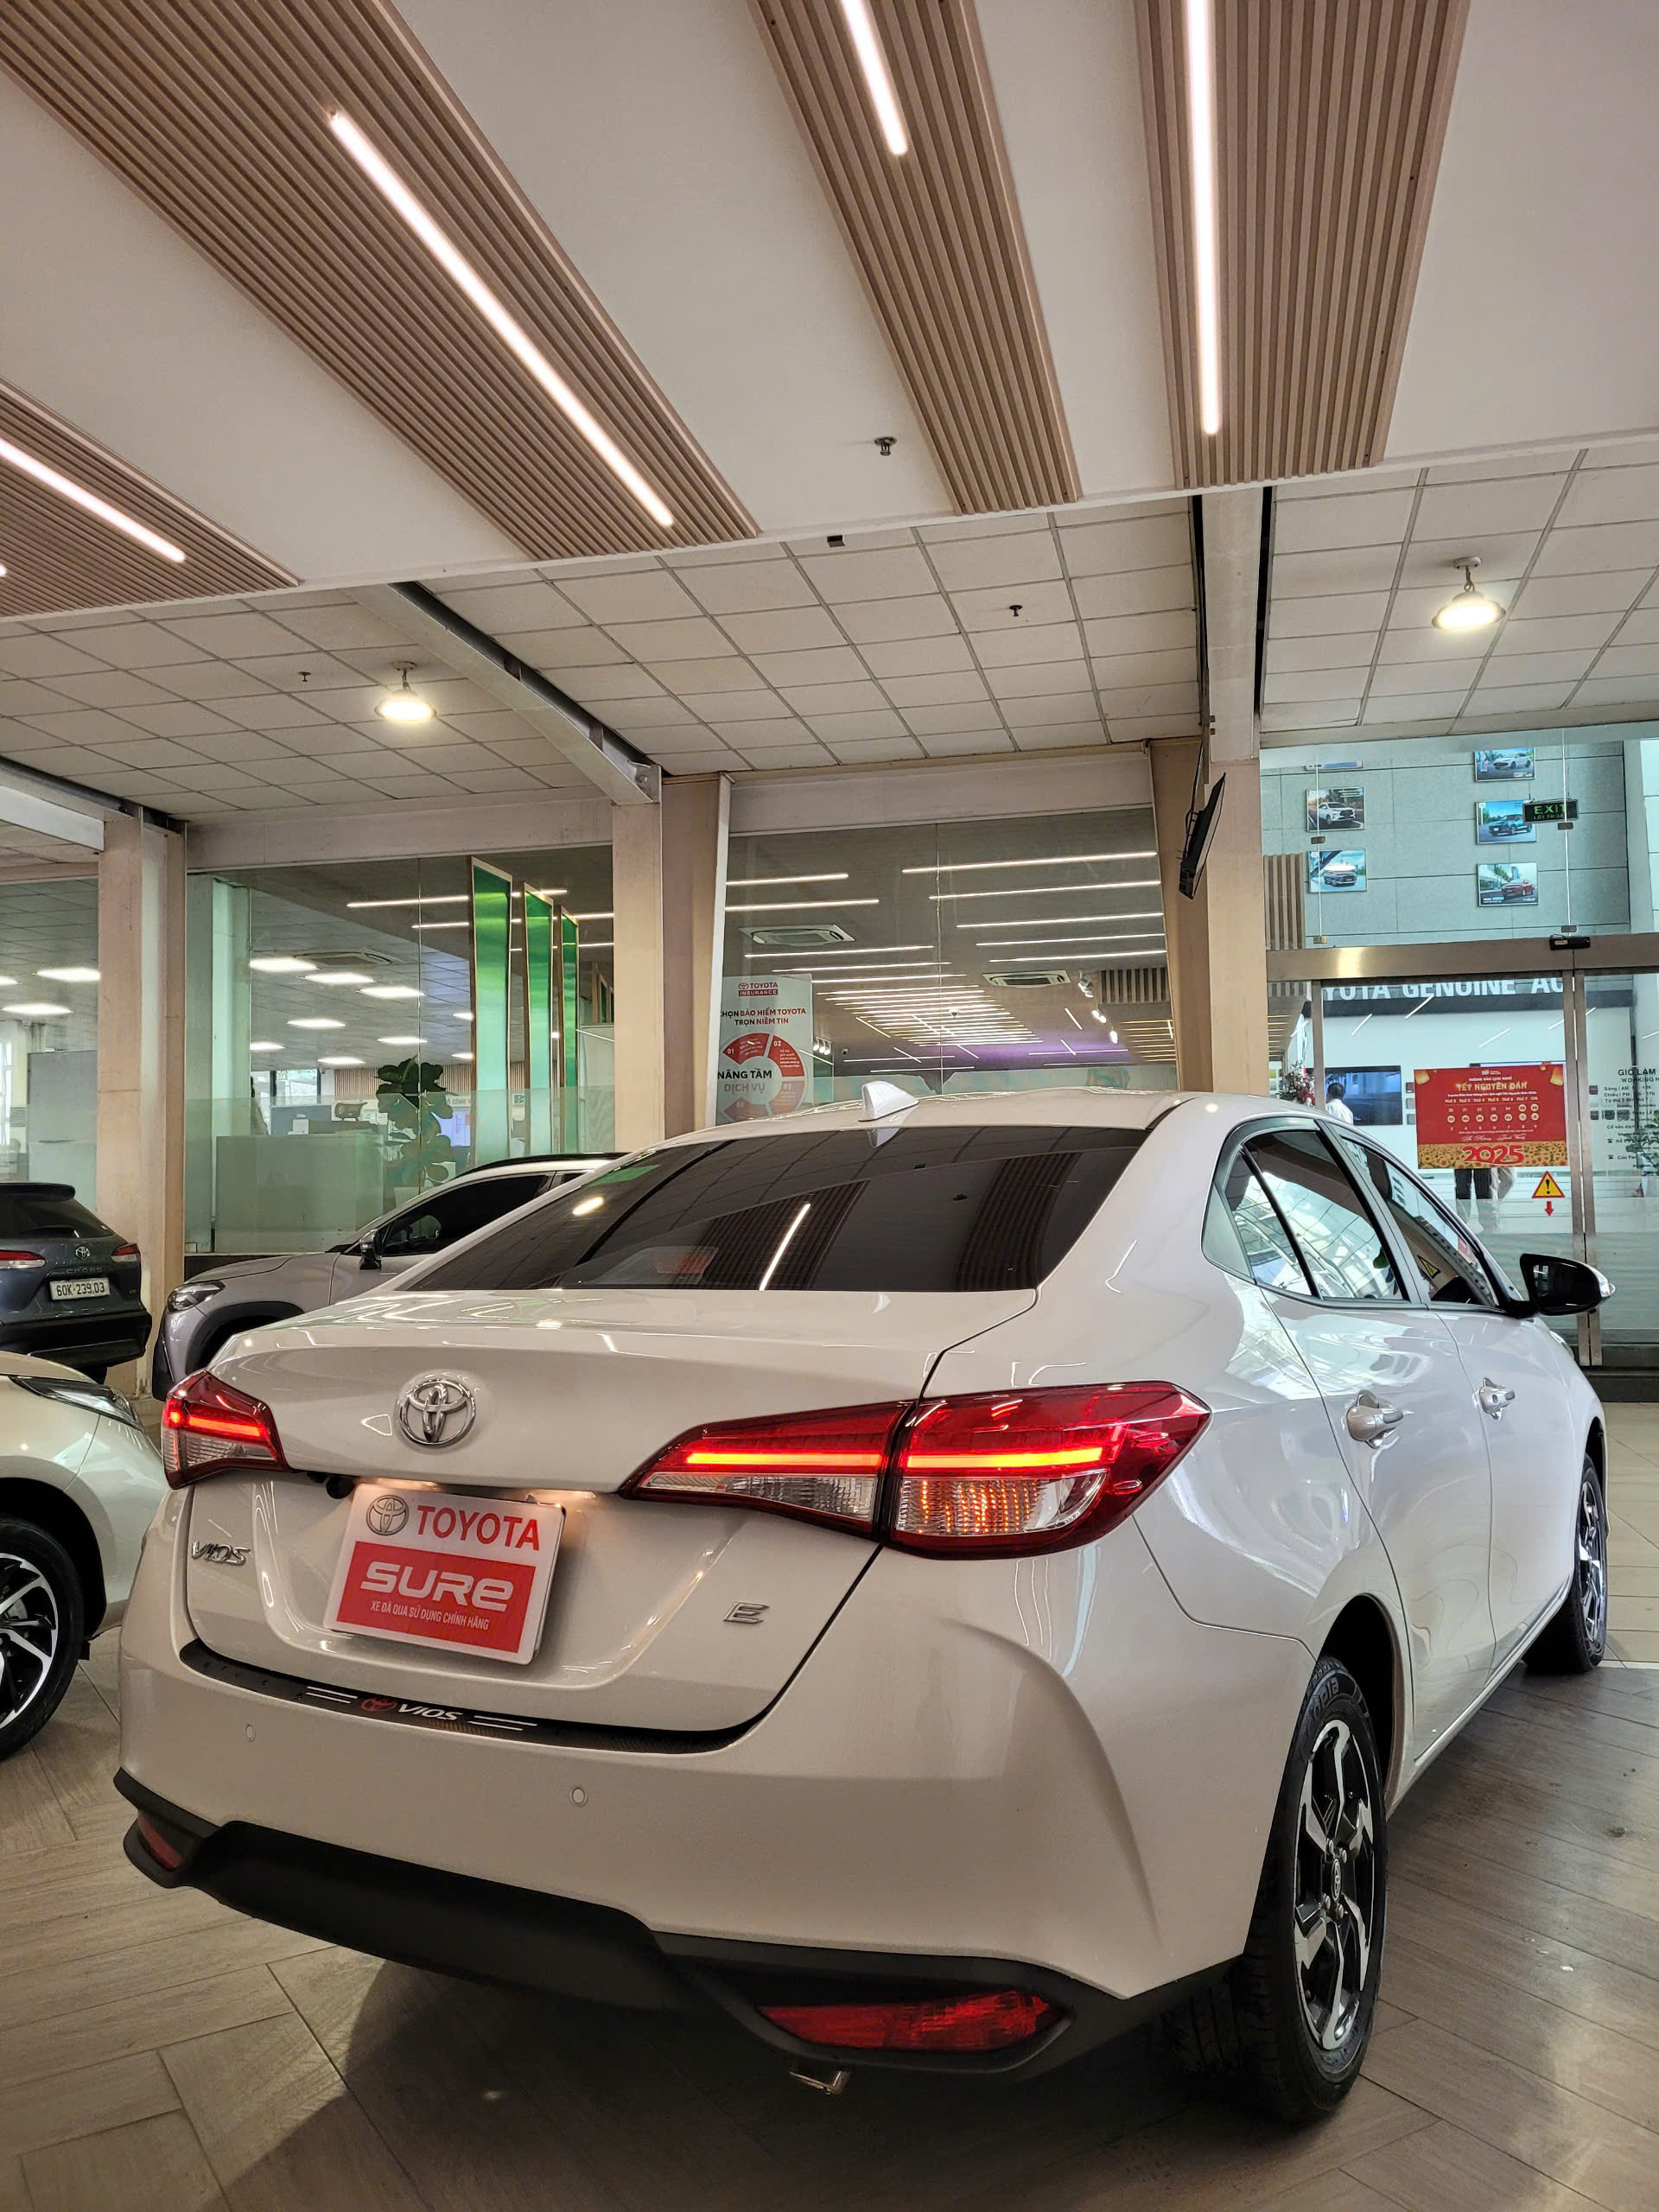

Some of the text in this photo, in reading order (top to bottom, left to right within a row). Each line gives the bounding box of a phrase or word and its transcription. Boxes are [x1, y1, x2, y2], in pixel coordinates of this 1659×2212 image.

[1534, 804, 1567, 814] EXIT
[1402, 980, 1516, 998] GENUINE
[740, 1008, 756, 1017] BẢO
[756, 1017, 775, 1025] NIỀM
[718, 1068, 772, 1079] NÂNG TẦM
[724, 1083, 765, 1093] DỊCH VỤ
[1457, 1082, 1472, 1091] TẾT
[1474, 1082, 1507, 1091] NGUYÊN
[1461, 1145, 1525, 1164] 2025
[416, 1504, 540, 1551] TOYOTA
[191, 1541, 251, 1566] VIOS
[371, 1601, 490, 1630] XE ĐÃ QUA SỬ DỤNG CHÍNH HÃNG
[397, 1703, 463, 1720] VIOS
